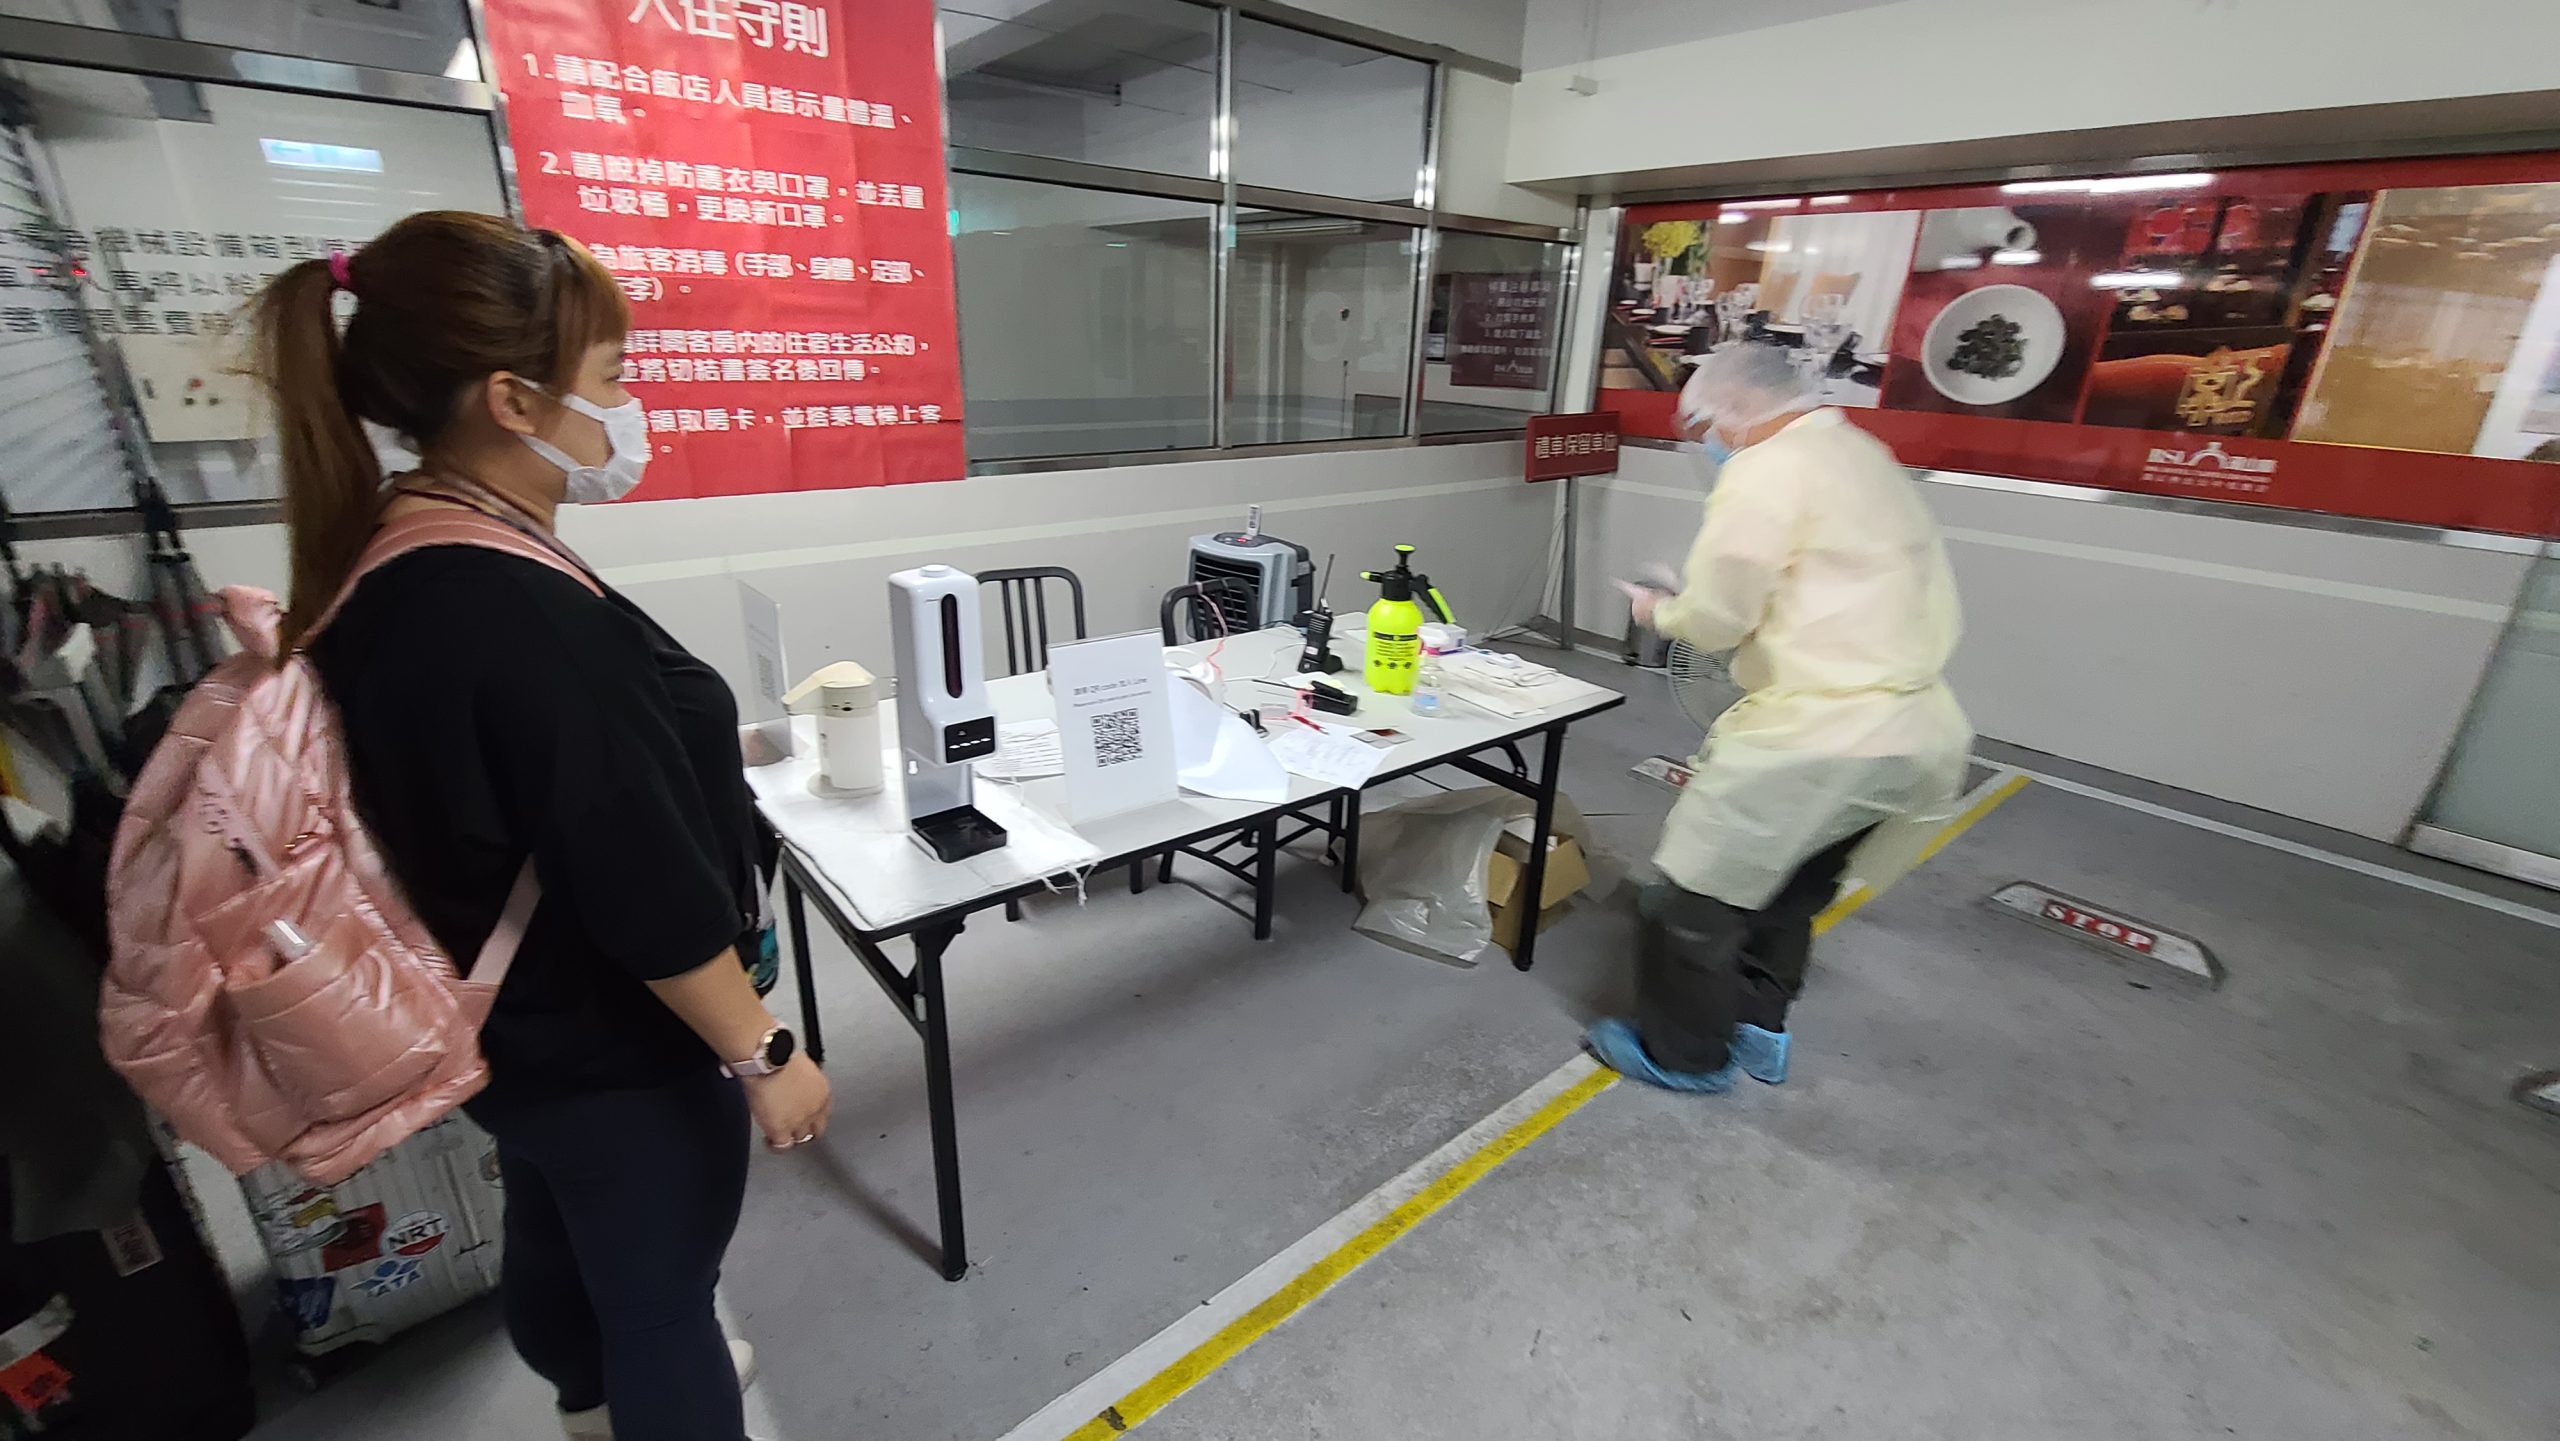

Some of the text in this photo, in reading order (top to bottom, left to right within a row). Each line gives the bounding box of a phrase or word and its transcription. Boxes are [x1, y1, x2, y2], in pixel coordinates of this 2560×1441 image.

[628, 0, 829, 57] 入住守則
[2049, 903, 2153, 948] STOP
[388, 1217, 443, 1250] NRT
